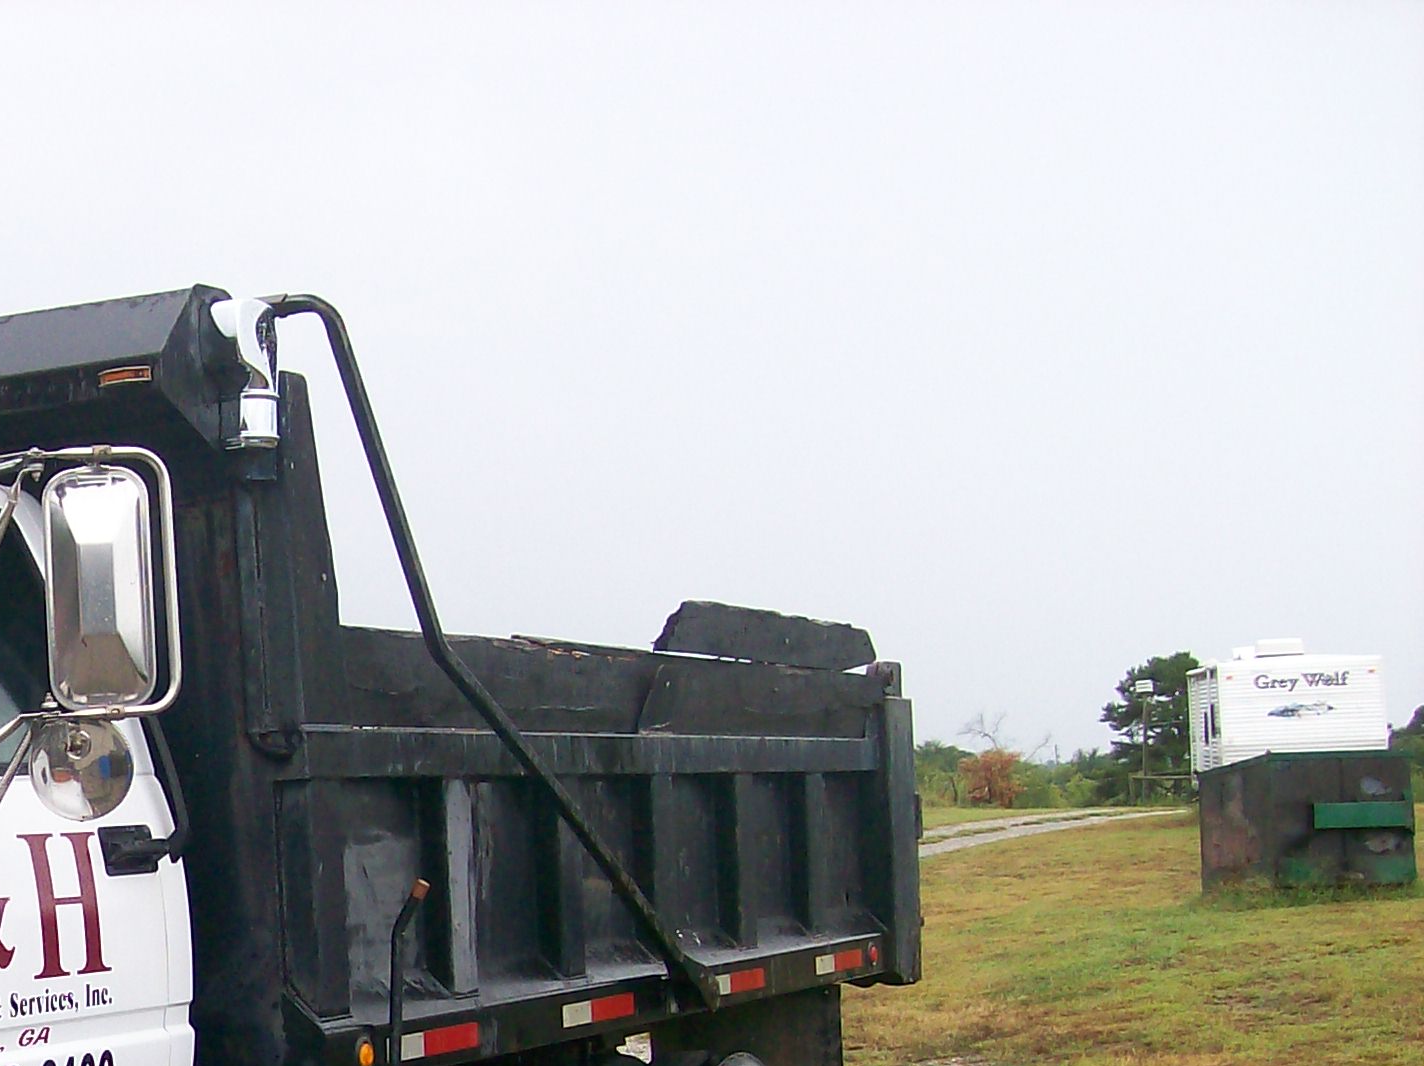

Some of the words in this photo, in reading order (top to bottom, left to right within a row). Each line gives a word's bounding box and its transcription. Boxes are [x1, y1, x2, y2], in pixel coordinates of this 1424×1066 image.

[1254, 673, 1298, 692] Grey
[1302, 671, 1350, 687] Wolf
[17, 832, 113, 979] H
[9, 989, 80, 1018] Services,
[85, 984, 114, 1009] Inc.
[18, 1026, 51, 1047] GA
